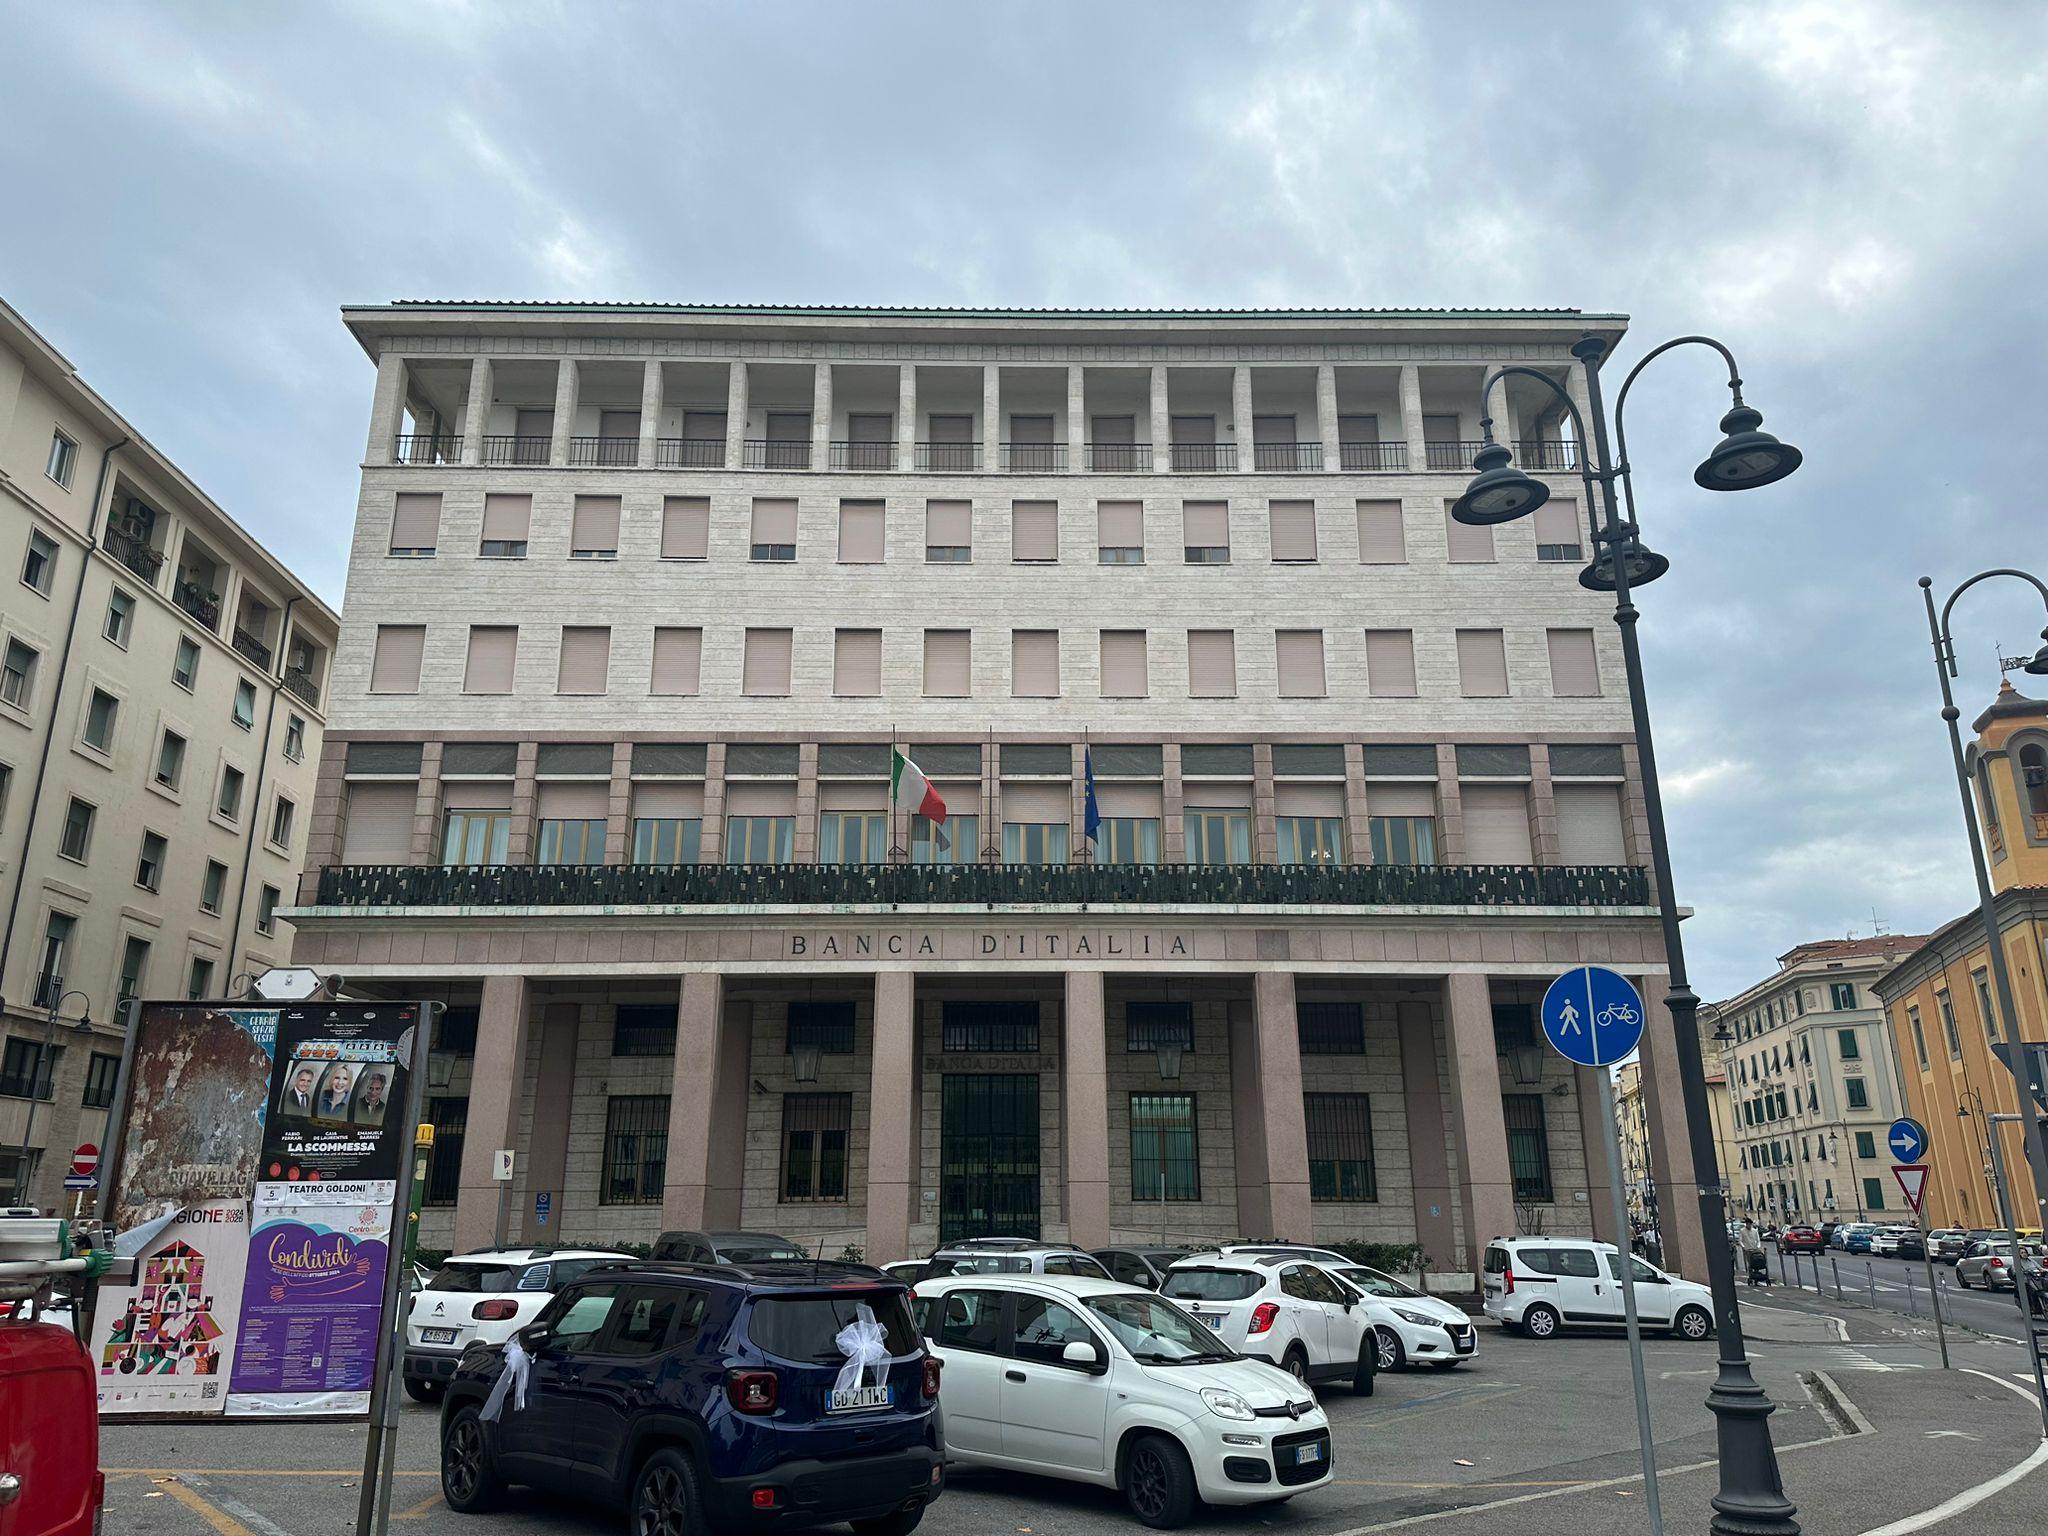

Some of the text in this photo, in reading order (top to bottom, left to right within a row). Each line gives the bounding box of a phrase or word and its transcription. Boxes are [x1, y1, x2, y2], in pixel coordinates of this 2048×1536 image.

[791, 934, 1187, 955] BANCA D'ITALIA
[926, 1056, 984, 1071] BANCA
[287, 1142, 376, 1152] LA SCOMMESSA
[269, 1190, 275, 1198] 5
[289, 1185, 324, 1194] TEATRO
[325, 1184, 366, 1193] GOLDONI
[225, 1208, 244, 1216] 2024
[268, 1232, 353, 1269] Condividi
